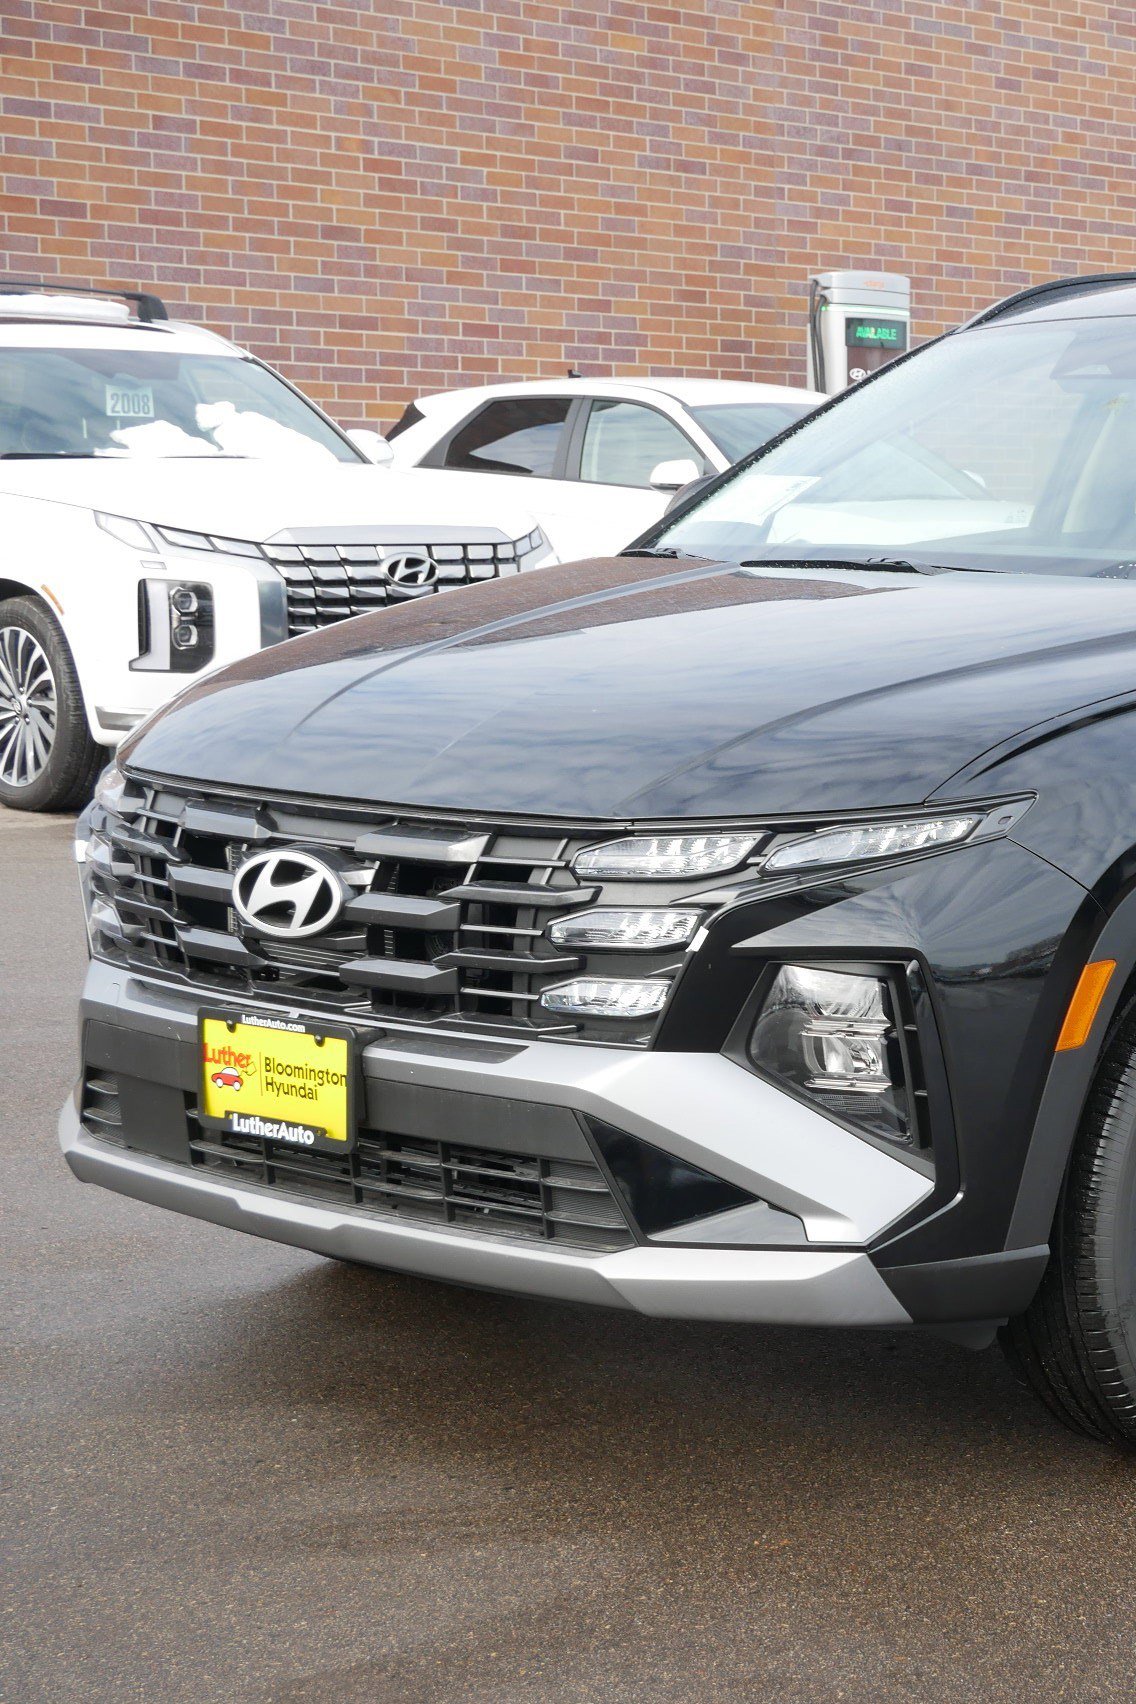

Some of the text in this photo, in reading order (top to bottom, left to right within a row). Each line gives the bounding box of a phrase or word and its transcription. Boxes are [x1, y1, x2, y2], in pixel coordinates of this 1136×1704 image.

[110, 393, 150, 415] 2008
[242, 1014, 306, 1033] LutherAuto.com
[203, 1043, 251, 1068] Luther
[264, 1056, 347, 1088] Bloomington
[265, 1076, 319, 1101] Hyundai
[232, 1112, 315, 1145] LutherAuto
